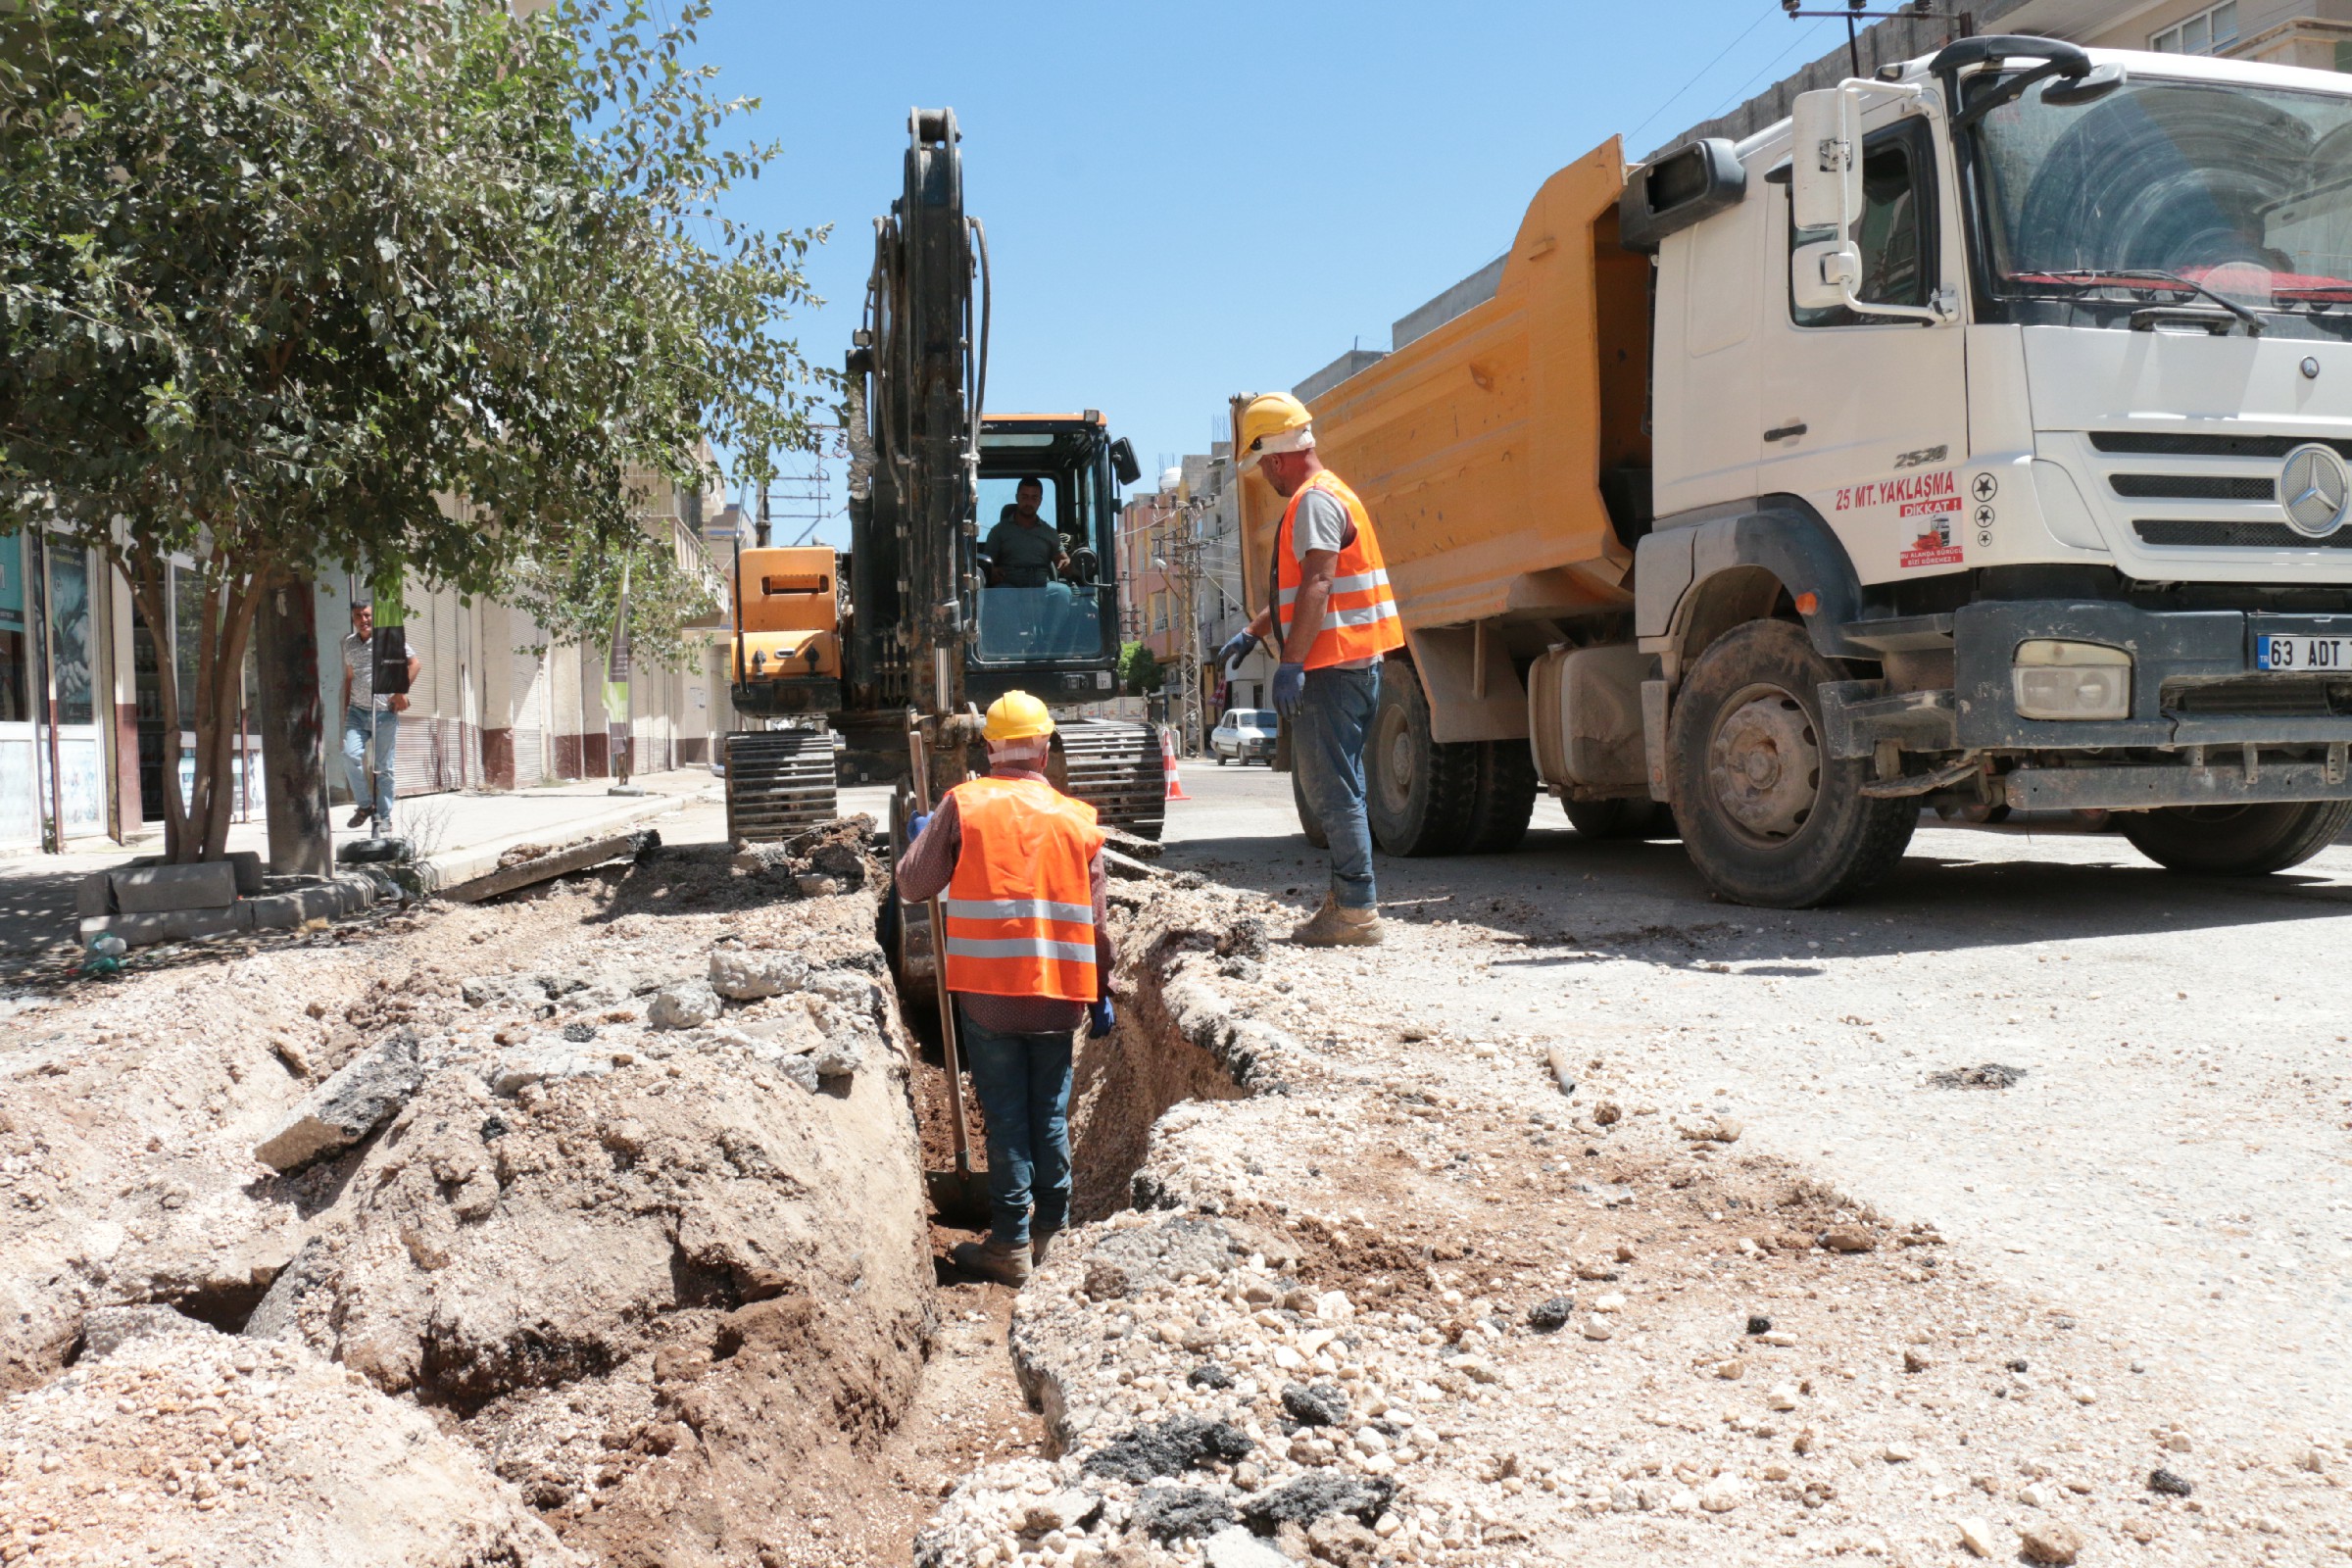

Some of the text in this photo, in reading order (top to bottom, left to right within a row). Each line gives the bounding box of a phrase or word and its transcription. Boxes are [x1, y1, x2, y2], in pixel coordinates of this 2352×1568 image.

[1836, 470, 1954, 511] 25 MT. YAKLAŞMA
[1904, 501, 1949, 516] DİKKAT
[2271, 640, 2293, 665] 63
[2308, 640, 2340, 665] ADT
